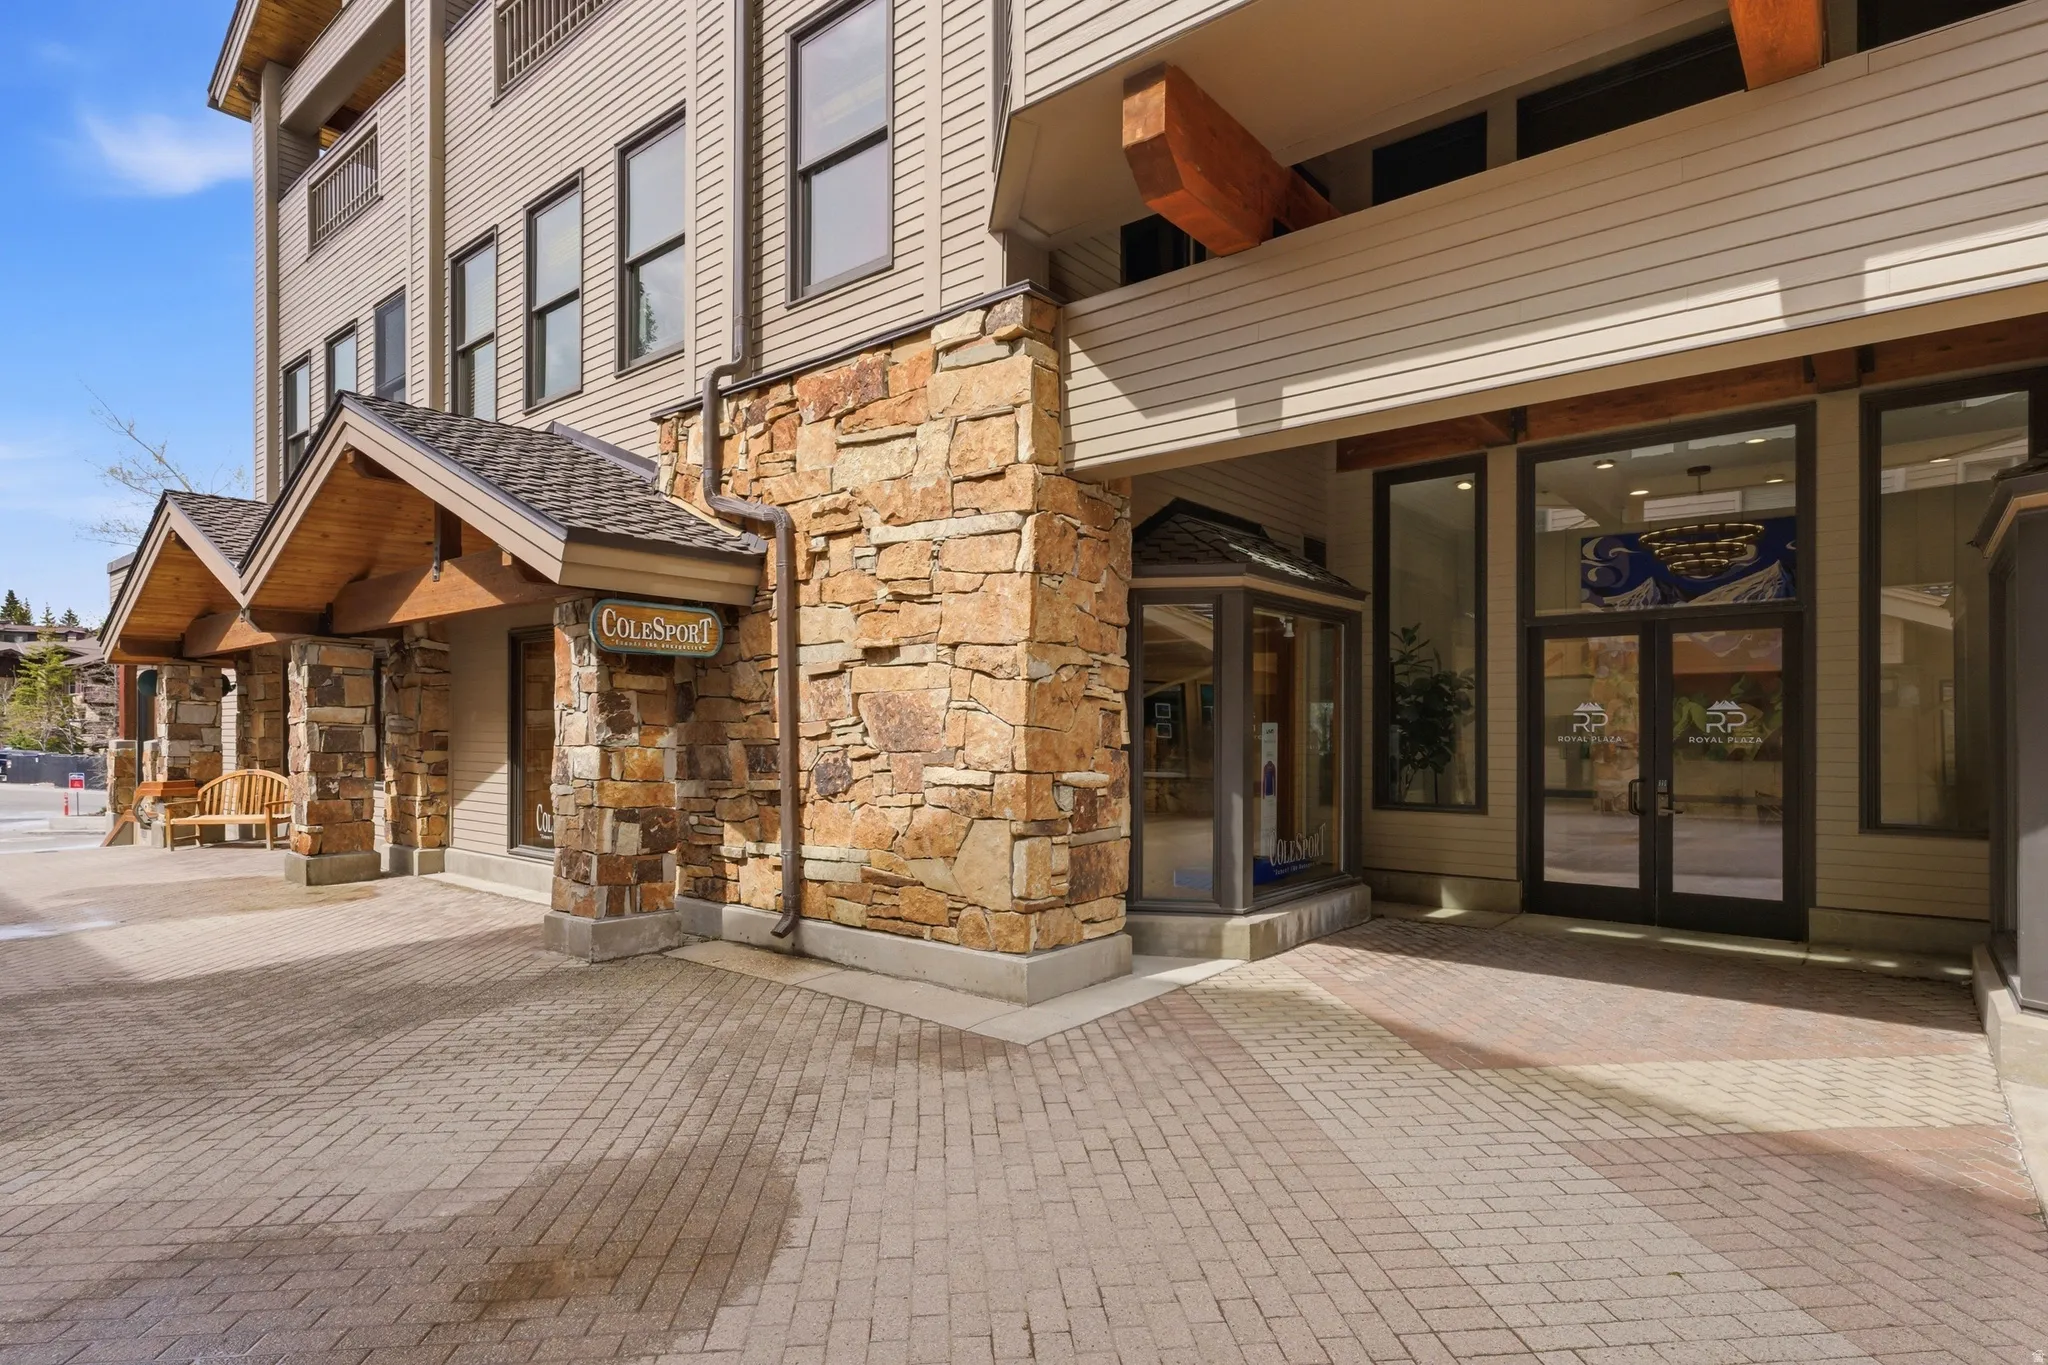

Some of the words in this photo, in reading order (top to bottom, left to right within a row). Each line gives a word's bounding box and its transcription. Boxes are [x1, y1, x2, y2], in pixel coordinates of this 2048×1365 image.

[1572, 712, 1609, 733] RP
[1705, 711, 1747, 733] RP
[1557, 735, 1588, 743] ROYAL
[1591, 735, 1622, 743] PLAZA
[1688, 736, 1724, 744] ROYAL
[1727, 736, 1763, 744] PLAZA
